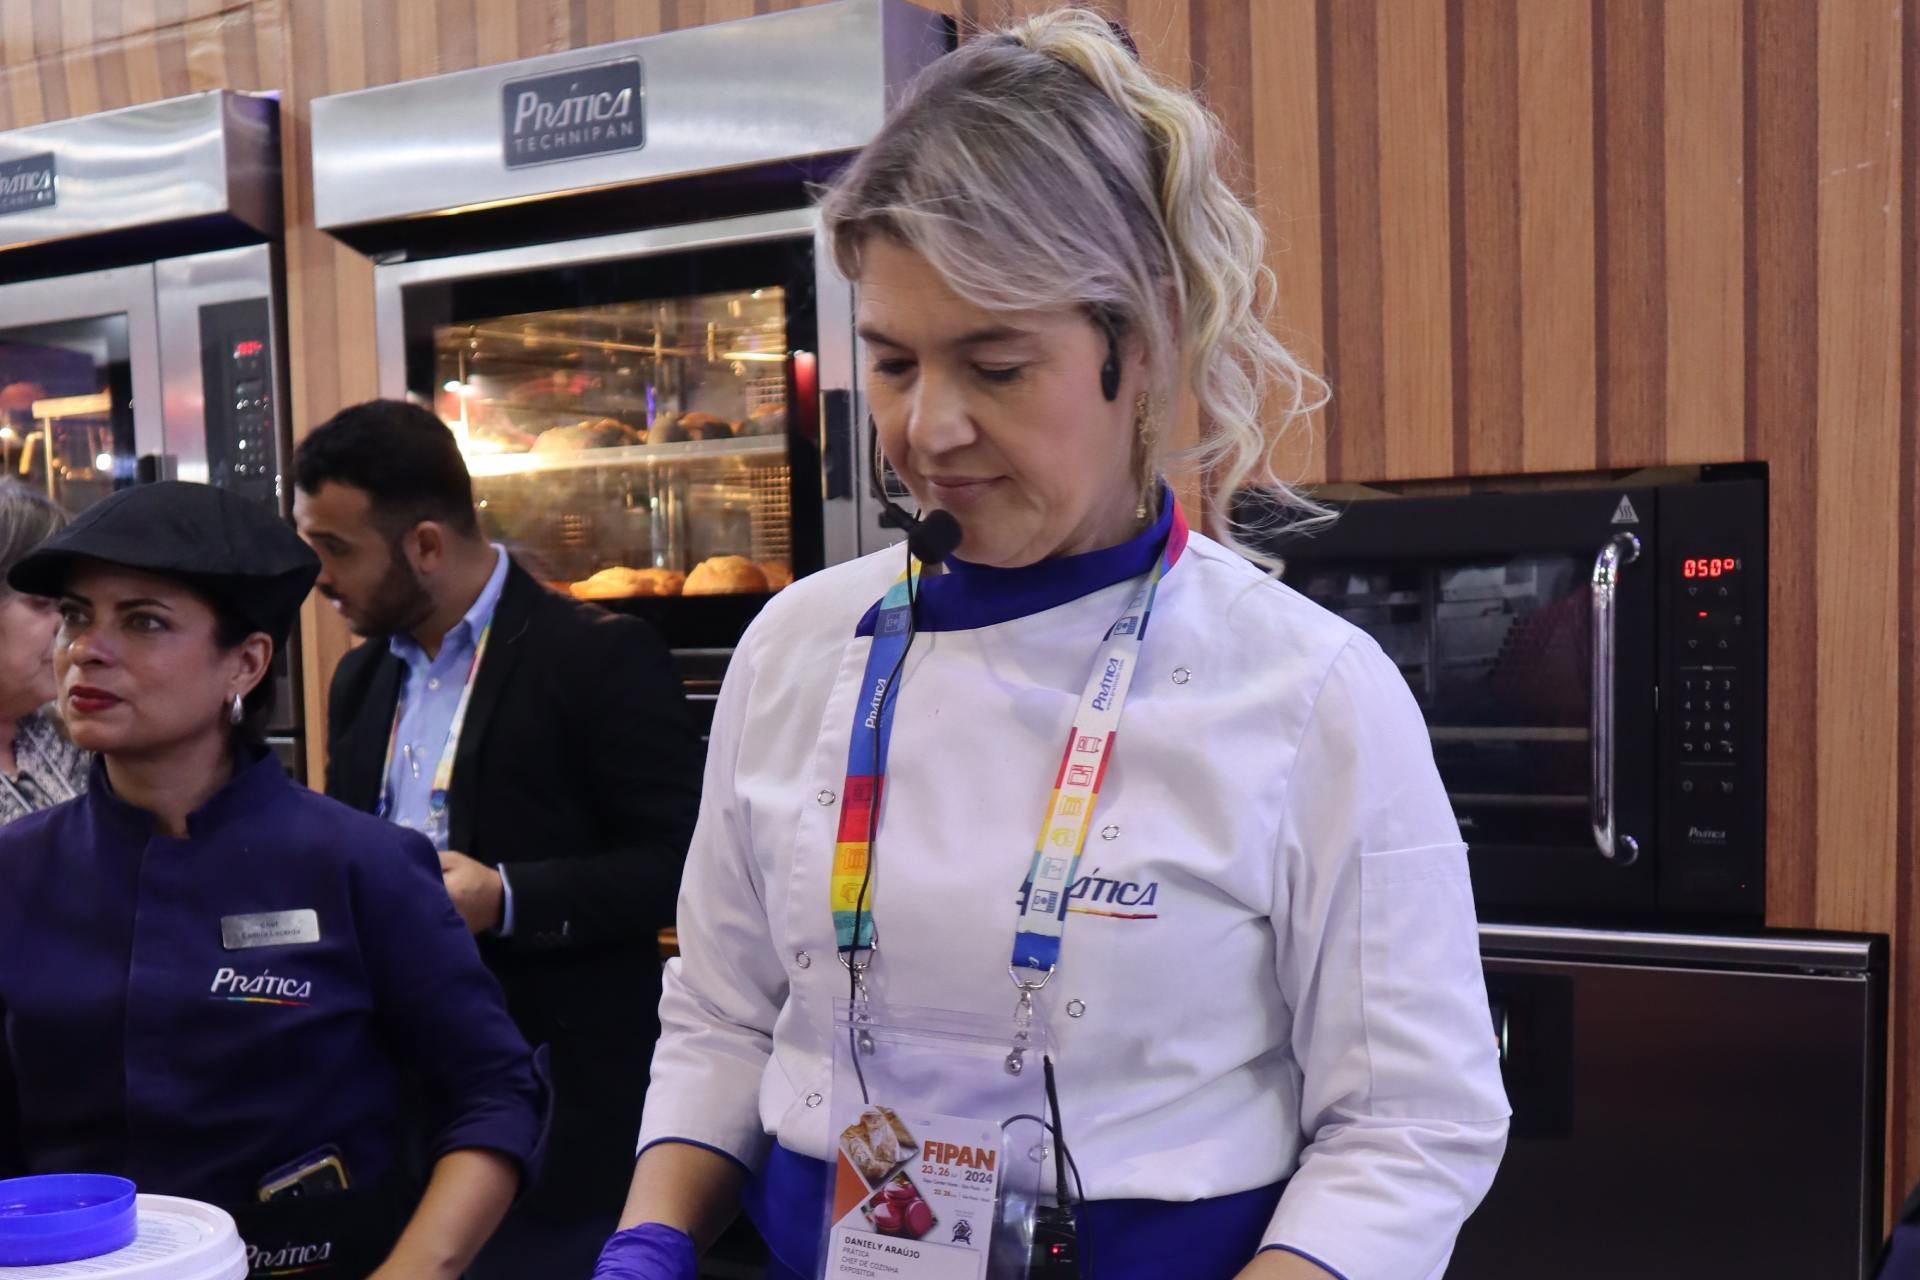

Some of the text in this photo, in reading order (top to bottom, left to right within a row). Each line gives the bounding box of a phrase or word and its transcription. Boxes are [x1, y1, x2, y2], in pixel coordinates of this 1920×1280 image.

[514, 121, 634, 153] TECHNIPAN
[923, 1140, 996, 1172] FIPAN
[964, 1170, 993, 1185] 2024
[844, 1236, 921, 1259] DANIELY ARAÚJO
